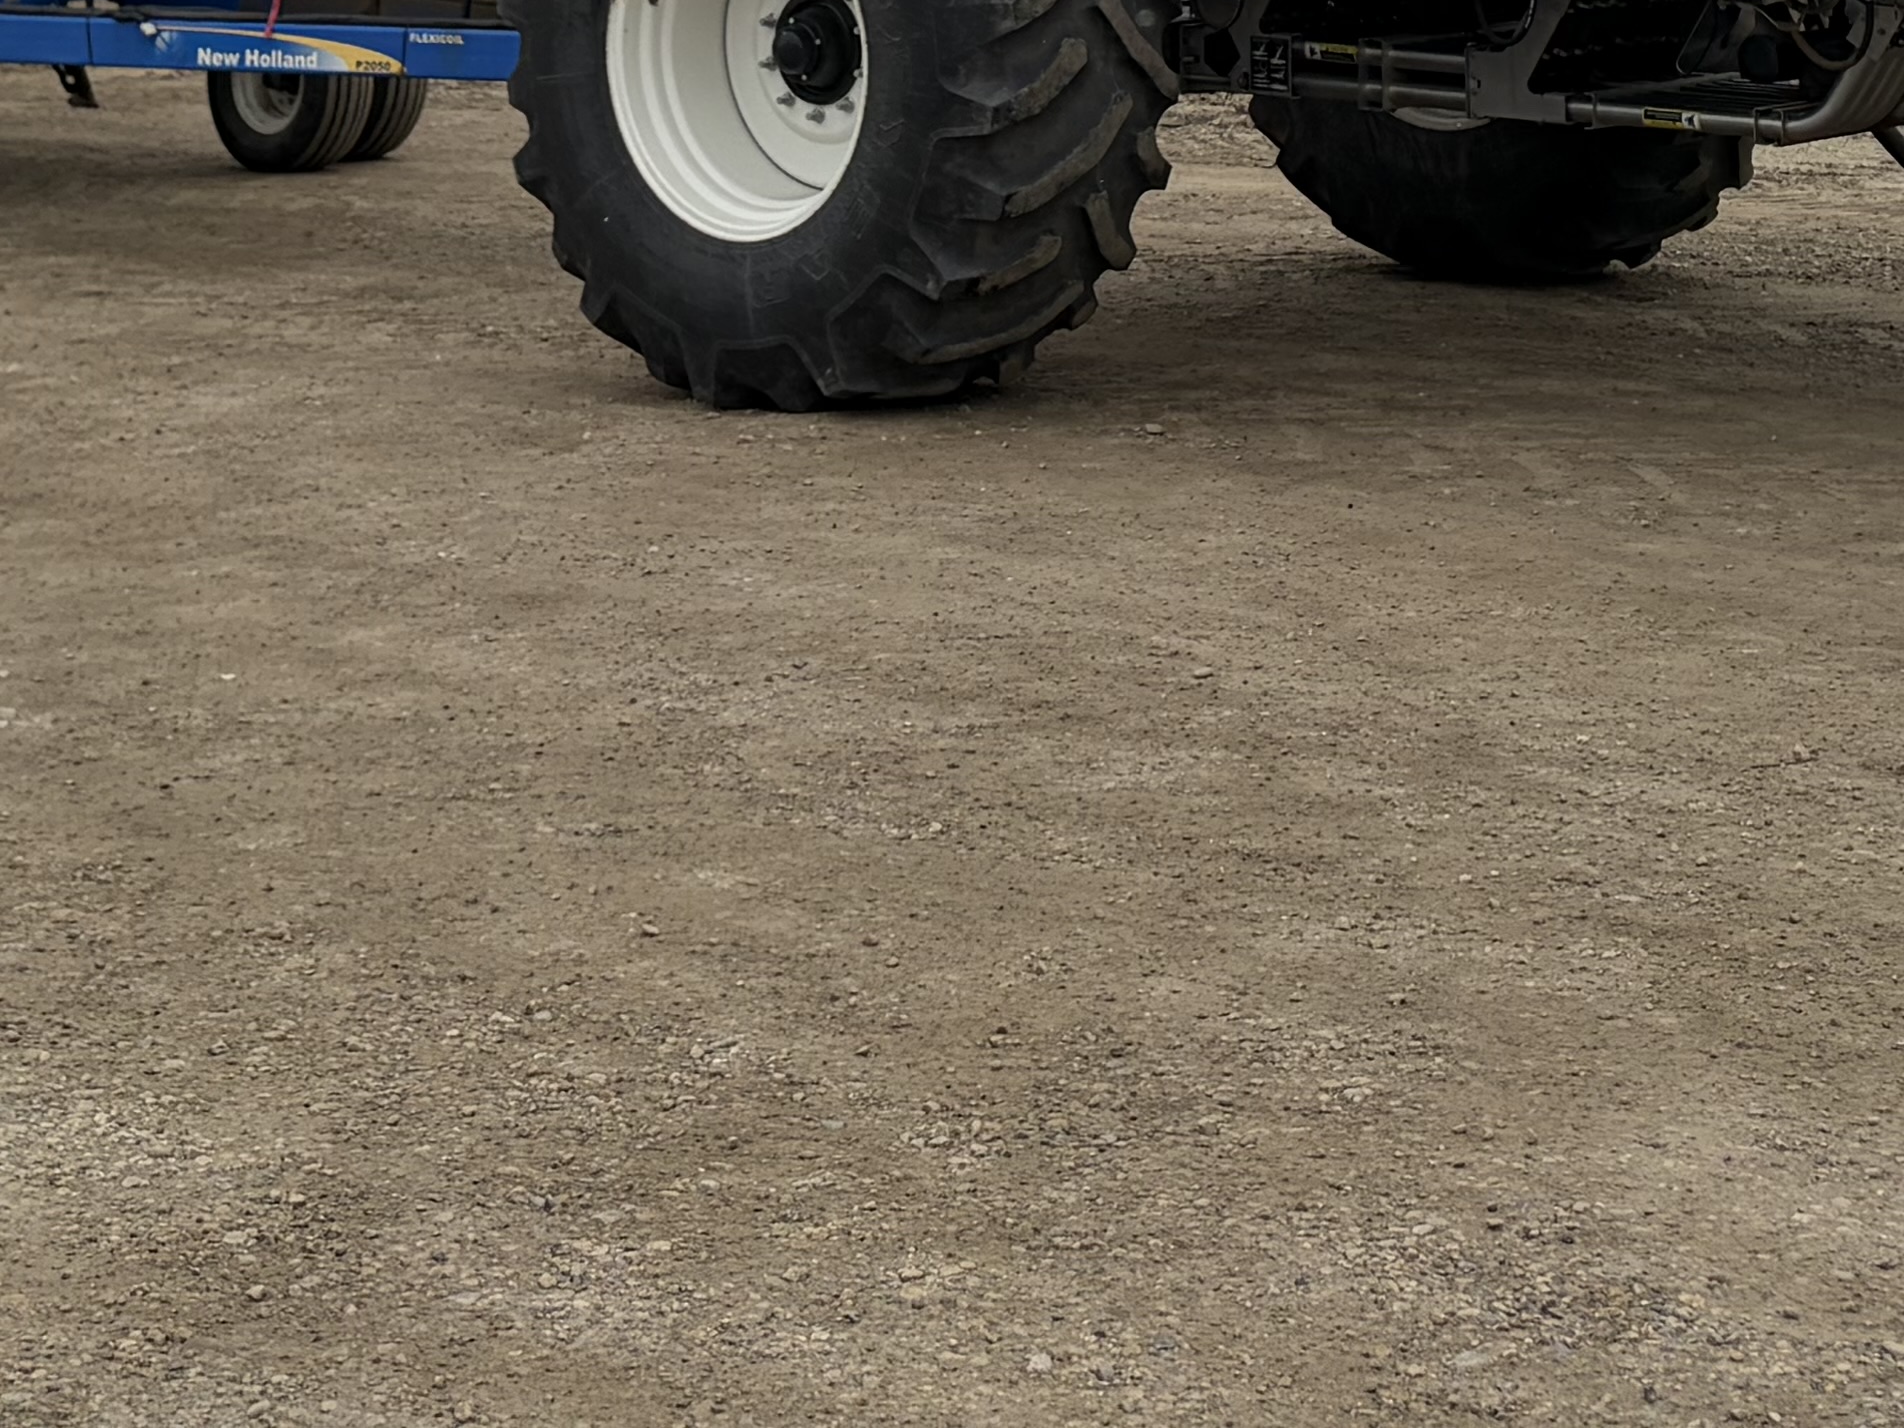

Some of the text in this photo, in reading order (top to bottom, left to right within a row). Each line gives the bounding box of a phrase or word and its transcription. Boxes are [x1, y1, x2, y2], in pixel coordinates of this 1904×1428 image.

[409, 32, 465, 45] FLEXICOIL
[197, 47, 318, 69] New Holland
[355, 60, 392, 72] P2050
